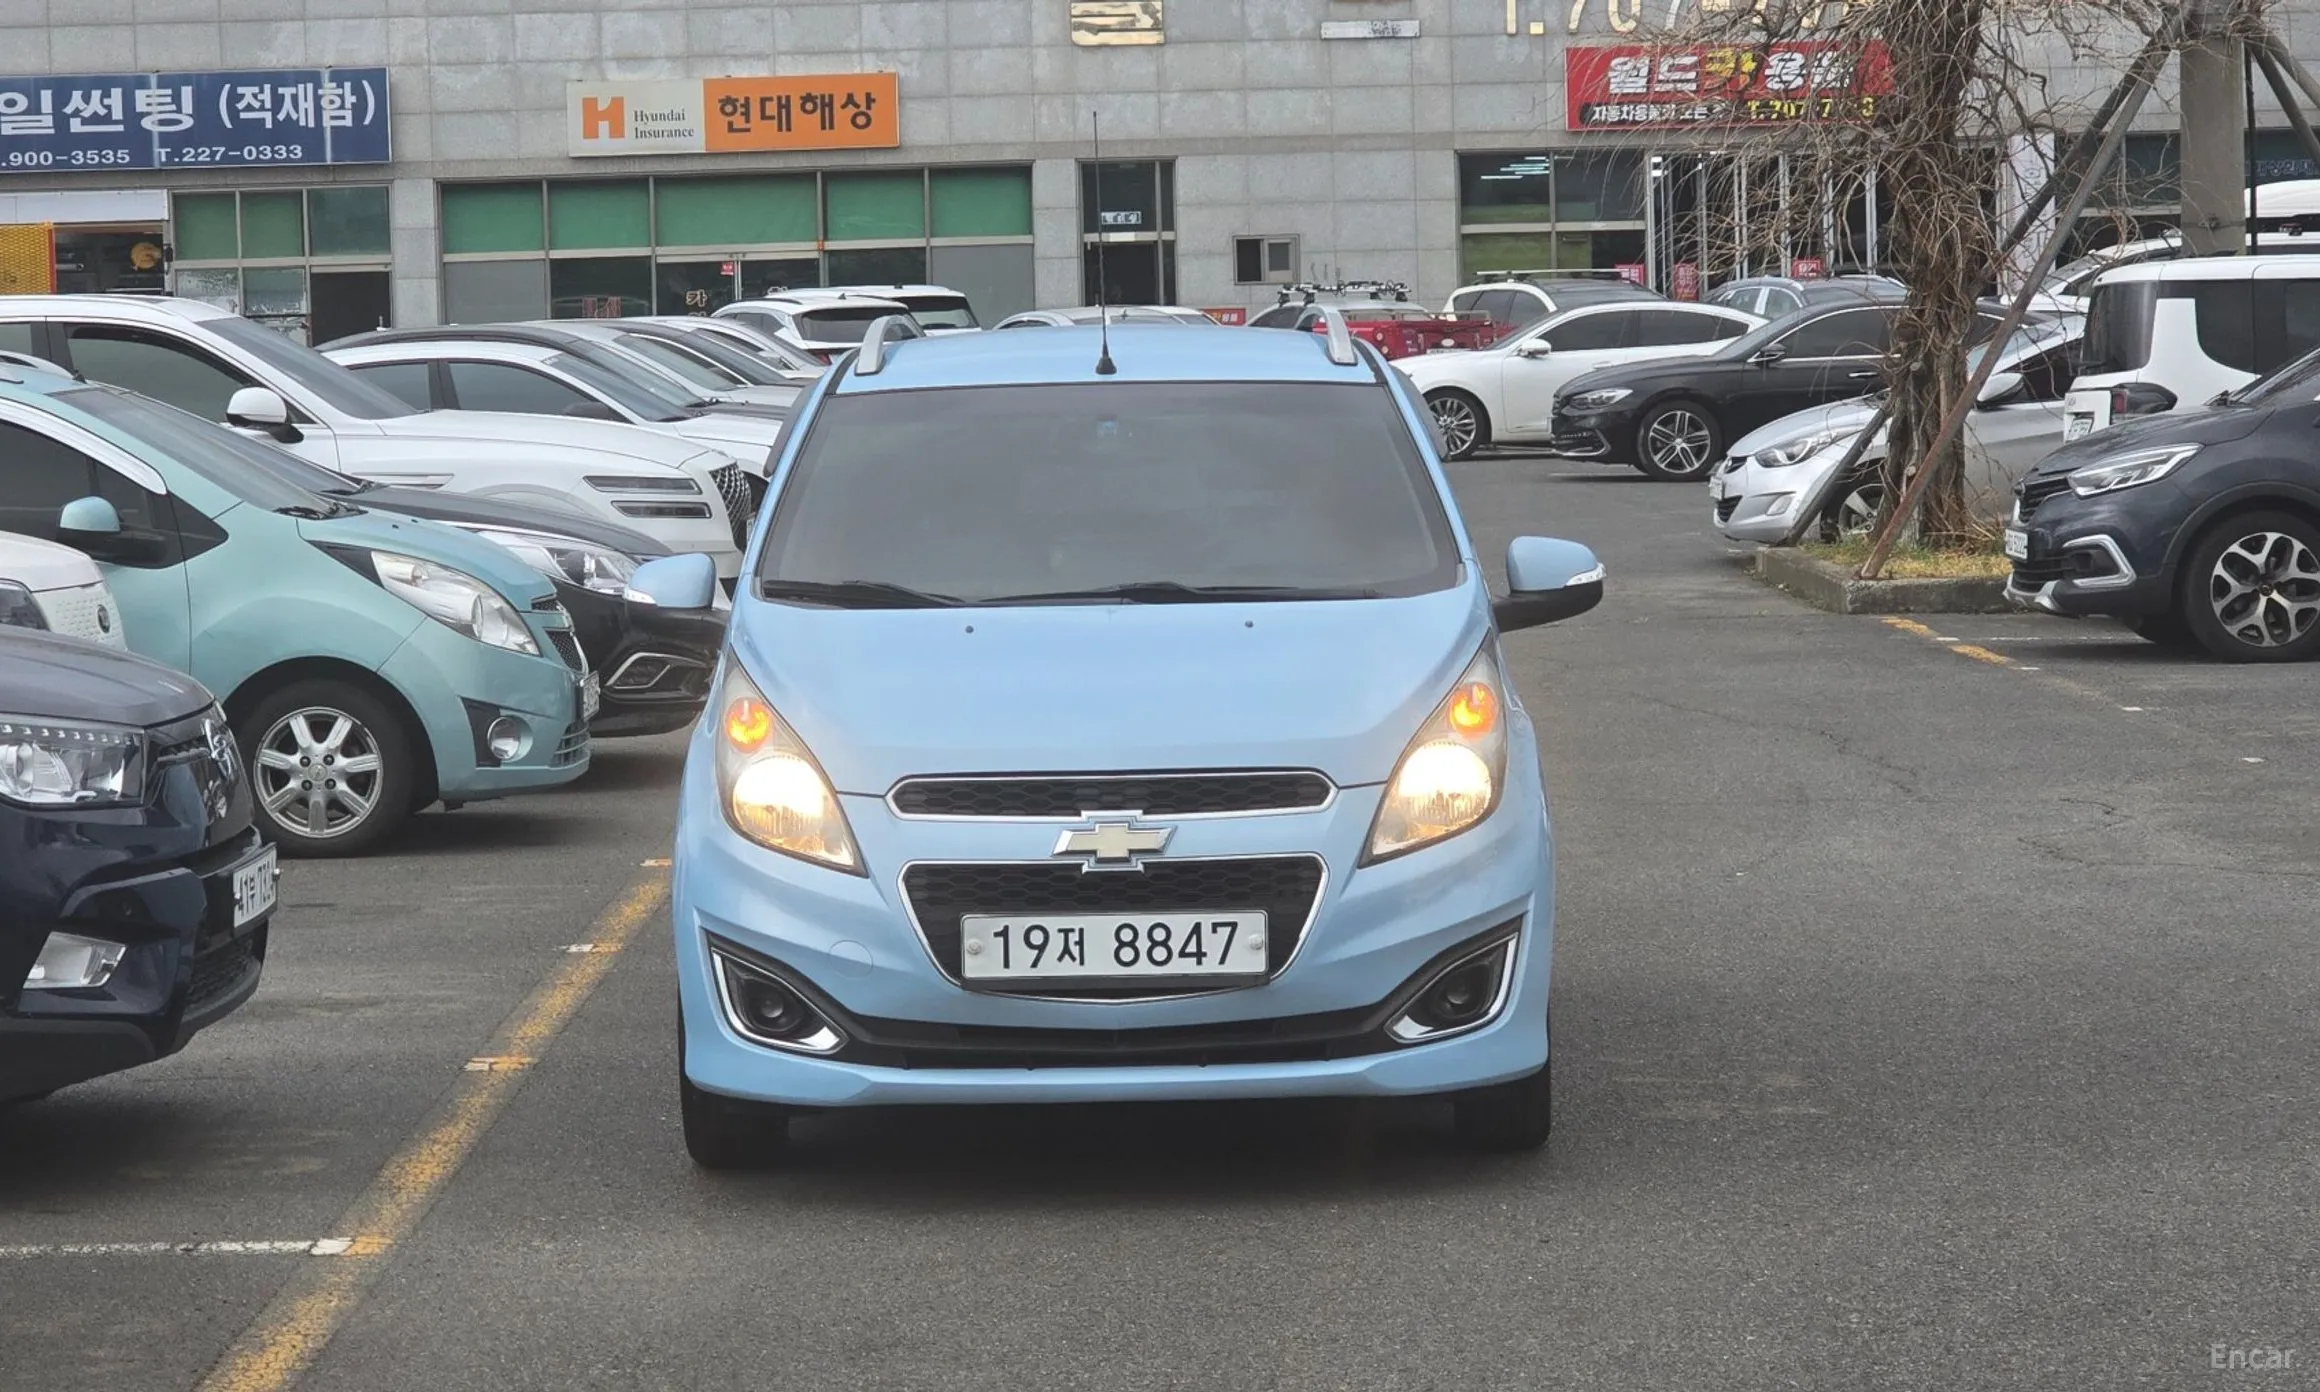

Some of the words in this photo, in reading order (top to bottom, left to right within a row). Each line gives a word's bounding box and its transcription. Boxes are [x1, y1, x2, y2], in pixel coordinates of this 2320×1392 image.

[0, 85, 195, 136] 일썬팅
[219, 79, 375, 129] (적재함)
[633, 108, 686, 126] Hyundai
[718, 91, 876, 133] 현대해상
[633, 126, 695, 140] Insurance
[155, 144, 303, 162] T.227-0333
[993, 924, 1085, 969] 19저
[1113, 921, 1239, 968] 8847
